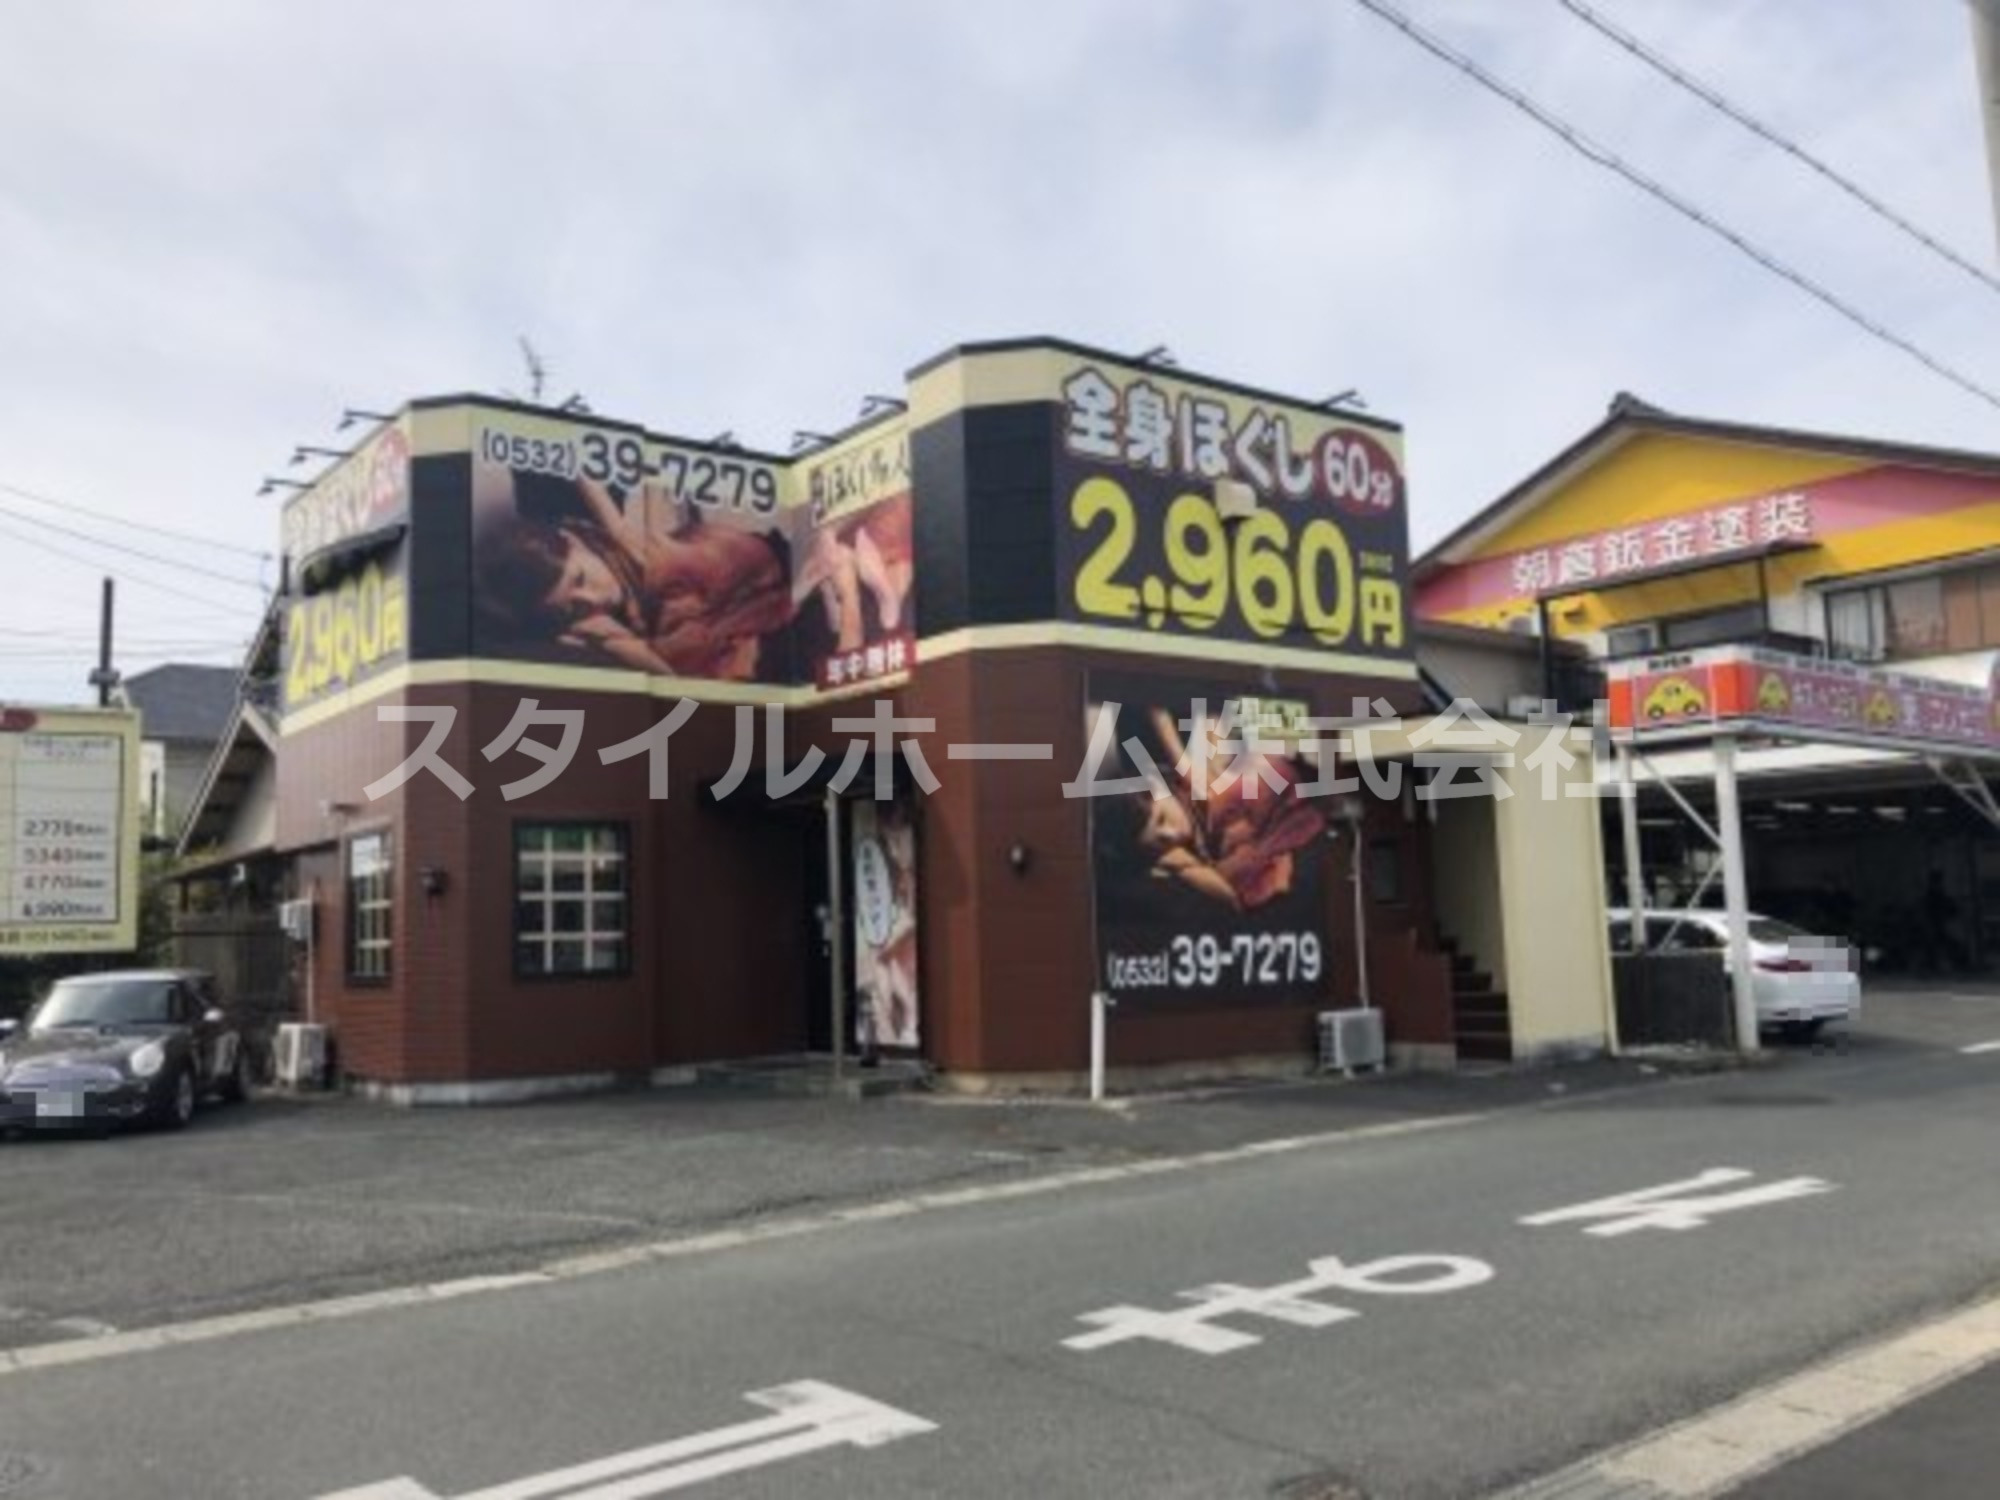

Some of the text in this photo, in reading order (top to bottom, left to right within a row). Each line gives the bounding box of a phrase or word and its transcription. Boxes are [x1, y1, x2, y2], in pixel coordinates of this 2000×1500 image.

[1063, 366, 1395, 508] 全身ほぐし 60分
